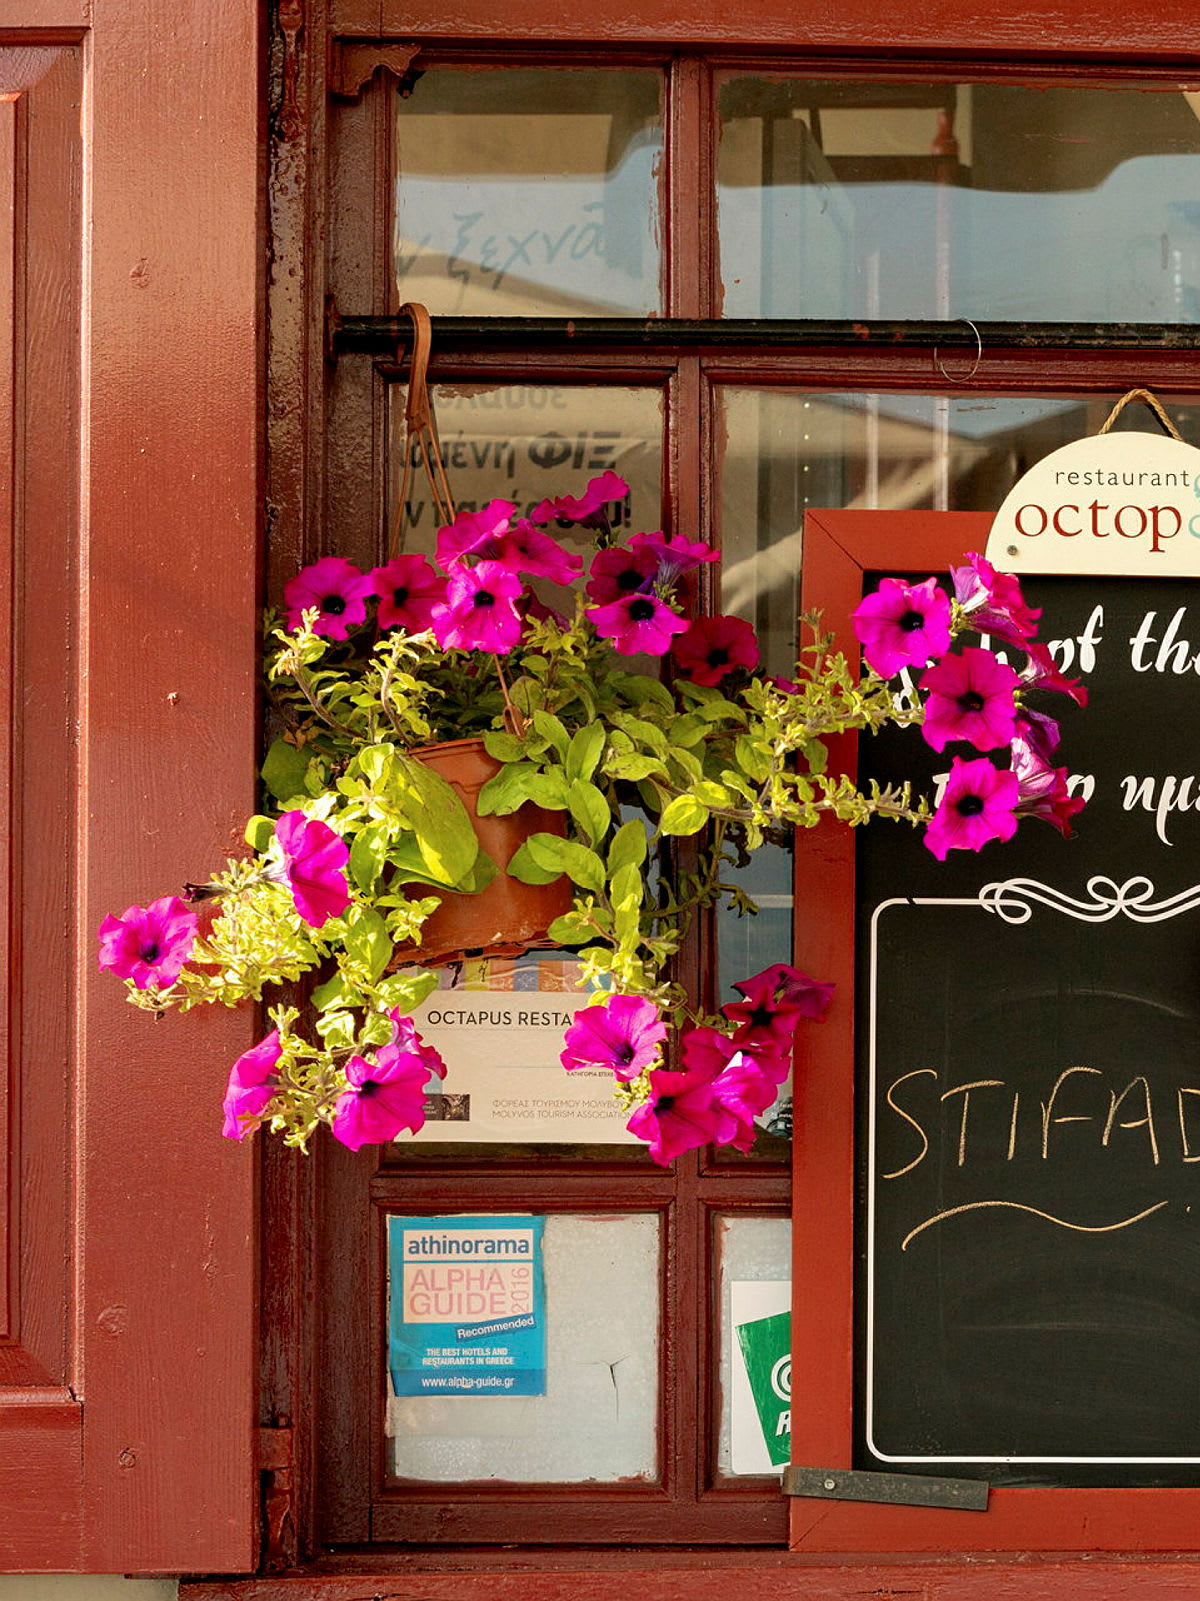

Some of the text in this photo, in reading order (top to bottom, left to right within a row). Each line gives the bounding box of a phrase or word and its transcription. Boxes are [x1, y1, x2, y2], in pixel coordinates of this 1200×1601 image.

[1055, 468, 1190, 487] restaurant
[427, 1010, 512, 1026] OCTAPUS
[538, 1110, 574, 1119] TOURISM
[408, 1235, 529, 1255] athinorama
[410, 1268, 505, 1292] ALPHA
[409, 1293, 506, 1316] GUIDE
[456, 1316, 534, 1339] Recommended
[422, 1357, 514, 1366] RESTAURANTS IN GREECE
[427, 1348, 508, 1356] THE BEST HOTELS AND
